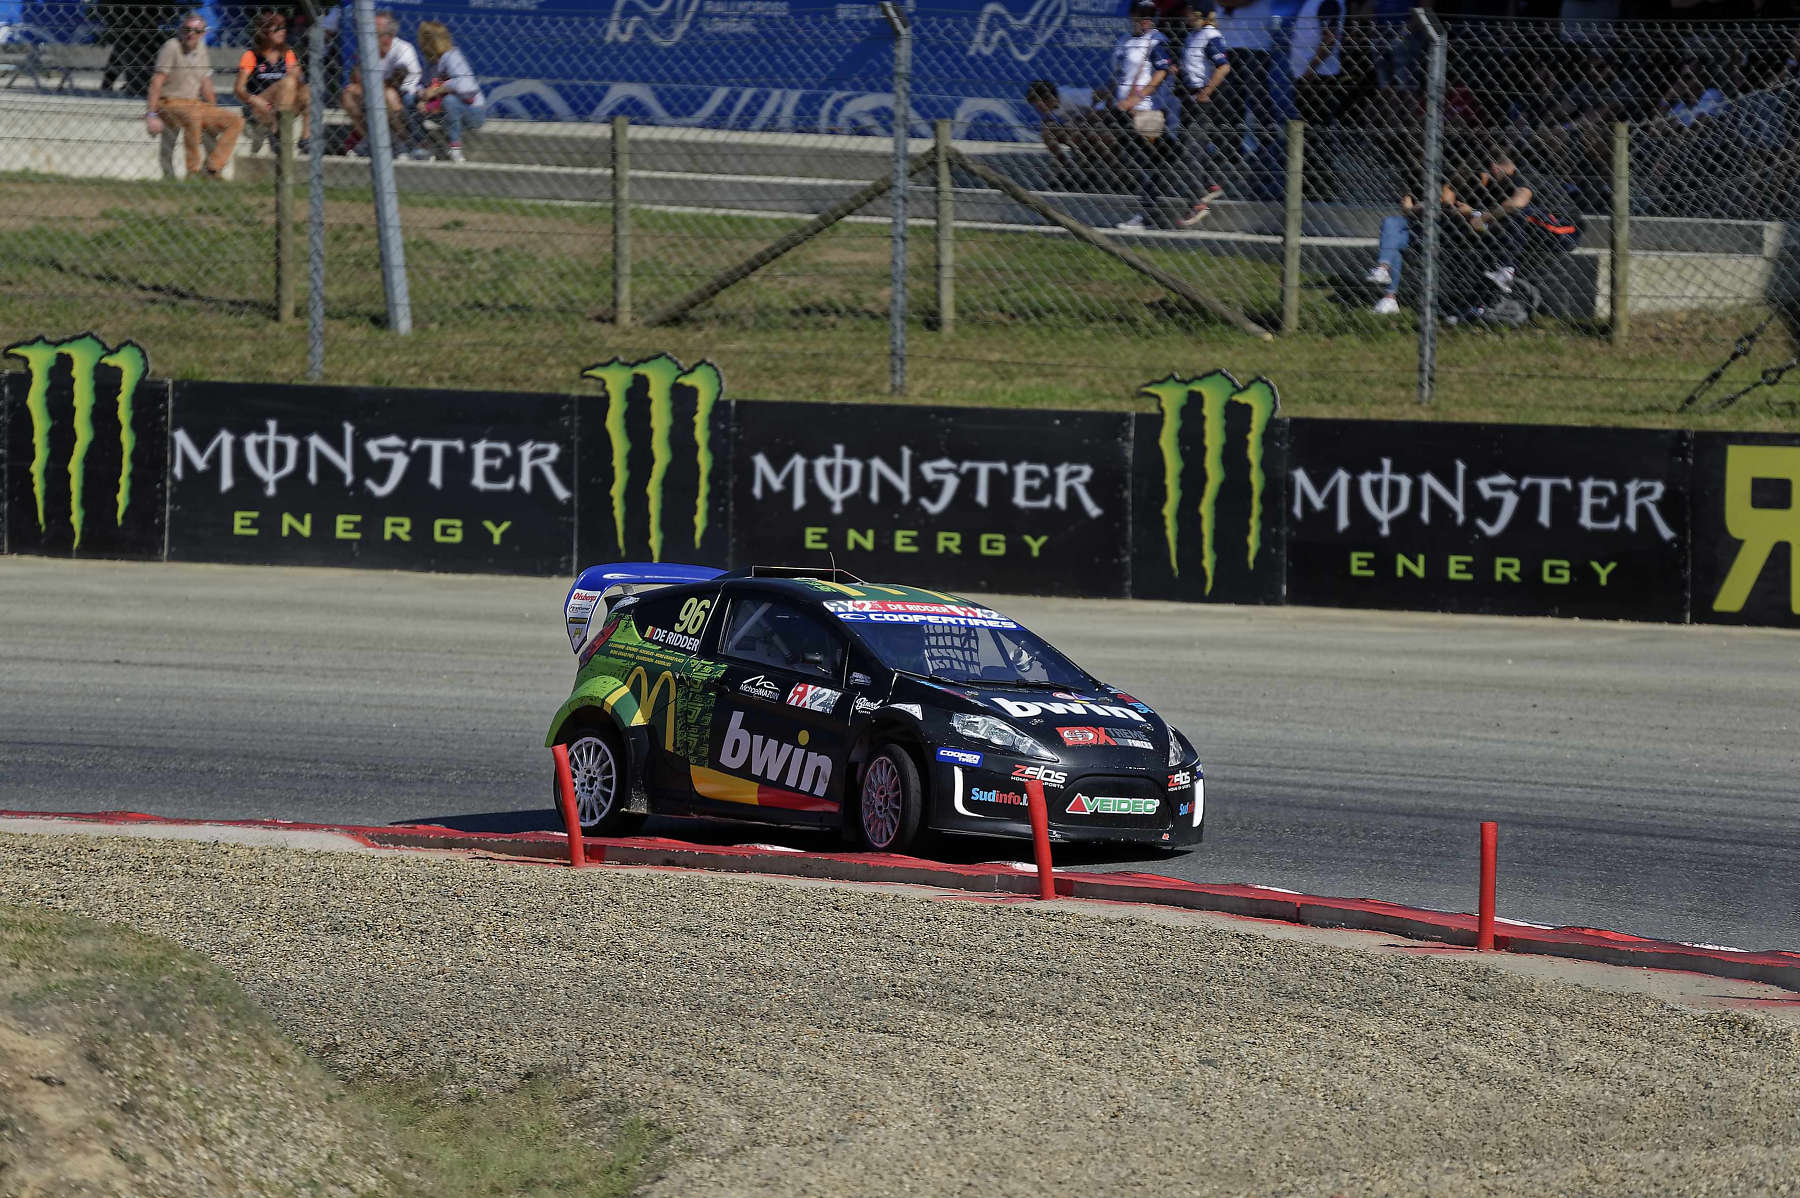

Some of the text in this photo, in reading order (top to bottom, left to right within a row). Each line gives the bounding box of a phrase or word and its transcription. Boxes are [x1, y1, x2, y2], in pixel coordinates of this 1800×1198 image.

[172, 419, 573, 500] MONSTER
[752, 443, 1103, 517] MONSTER
[1292, 457, 1675, 539] MONSTER
[232, 510, 512, 545] ENERGY
[804, 527, 1049, 557] ENERGY
[1349, 551, 1618, 587] ENERGY
[674, 597, 711, 635] 96
[886, 603, 907, 611] DE
[652, 628, 700, 652] DE RIDDER
[991, 697, 1147, 722] bwin
[719, 710, 833, 797] bwin
[1085, 797, 1159, 814] VEIDEC
